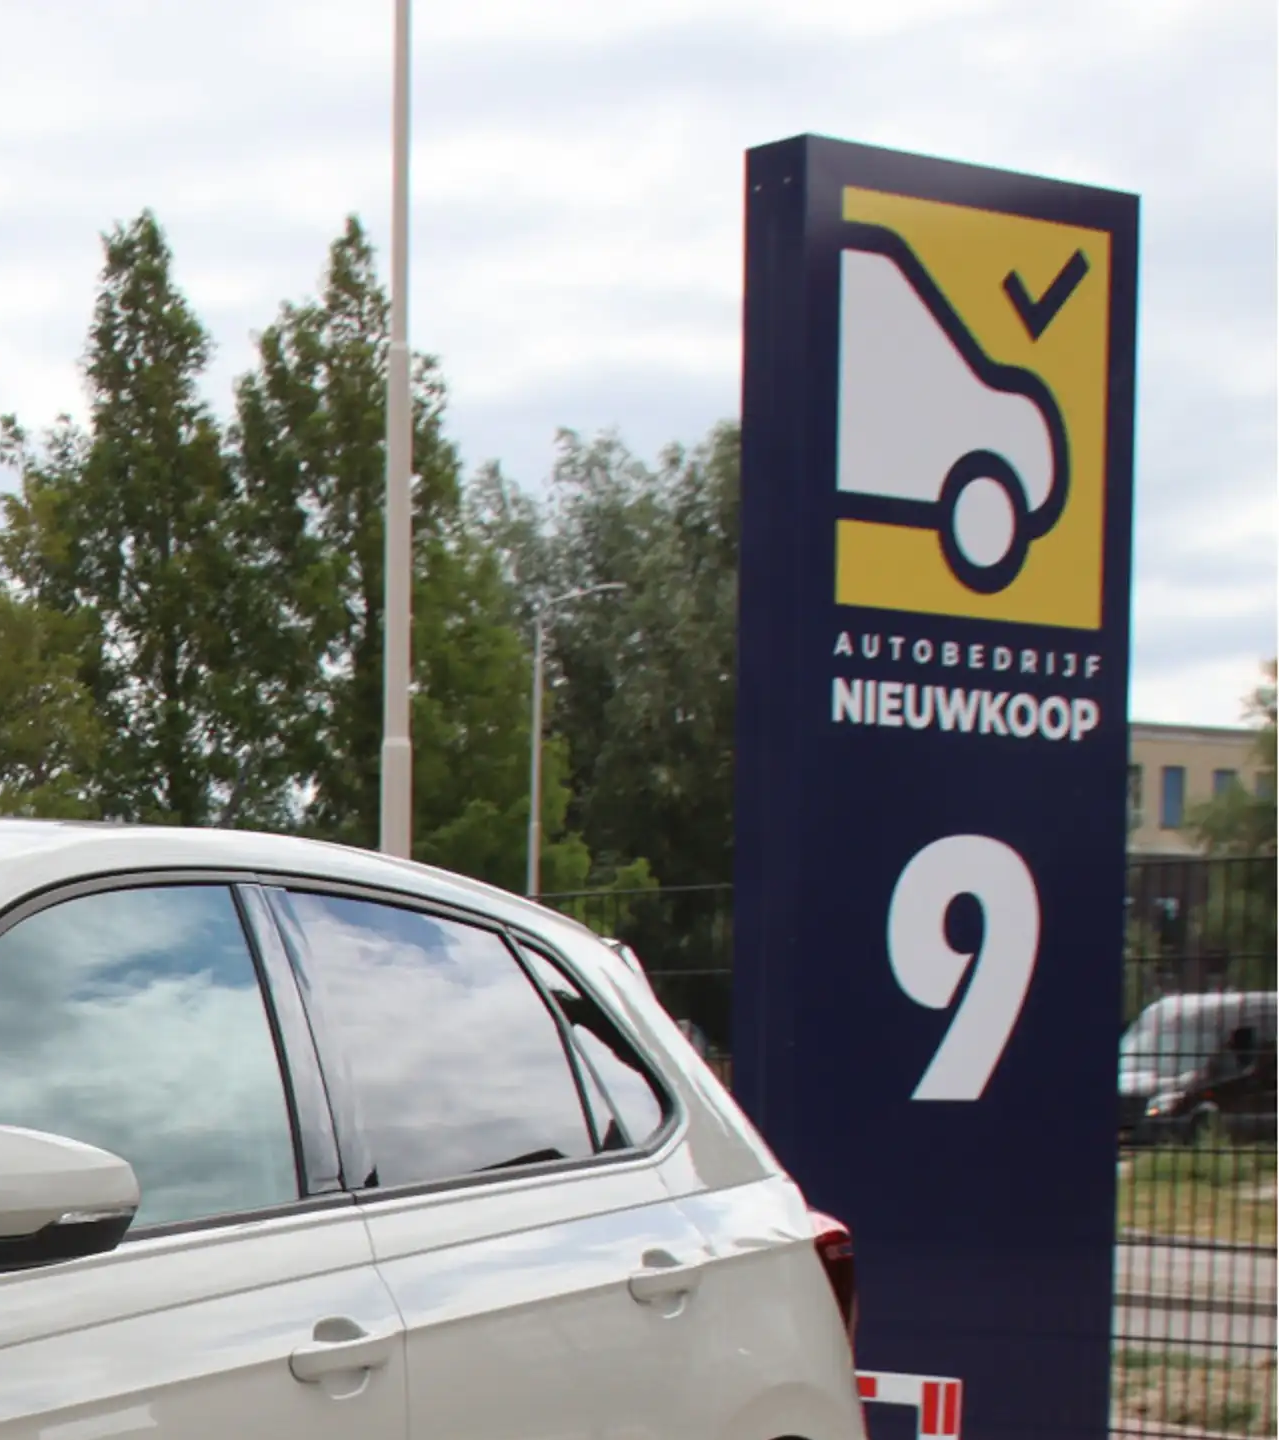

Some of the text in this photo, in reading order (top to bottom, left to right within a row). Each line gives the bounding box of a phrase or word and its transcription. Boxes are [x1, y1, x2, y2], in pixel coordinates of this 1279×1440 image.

[834, 631, 1102, 679] AUTOBEDRIJF
[831, 677, 1100, 742] NIEUWKOOP
[887, 834, 1040, 1100] 9
